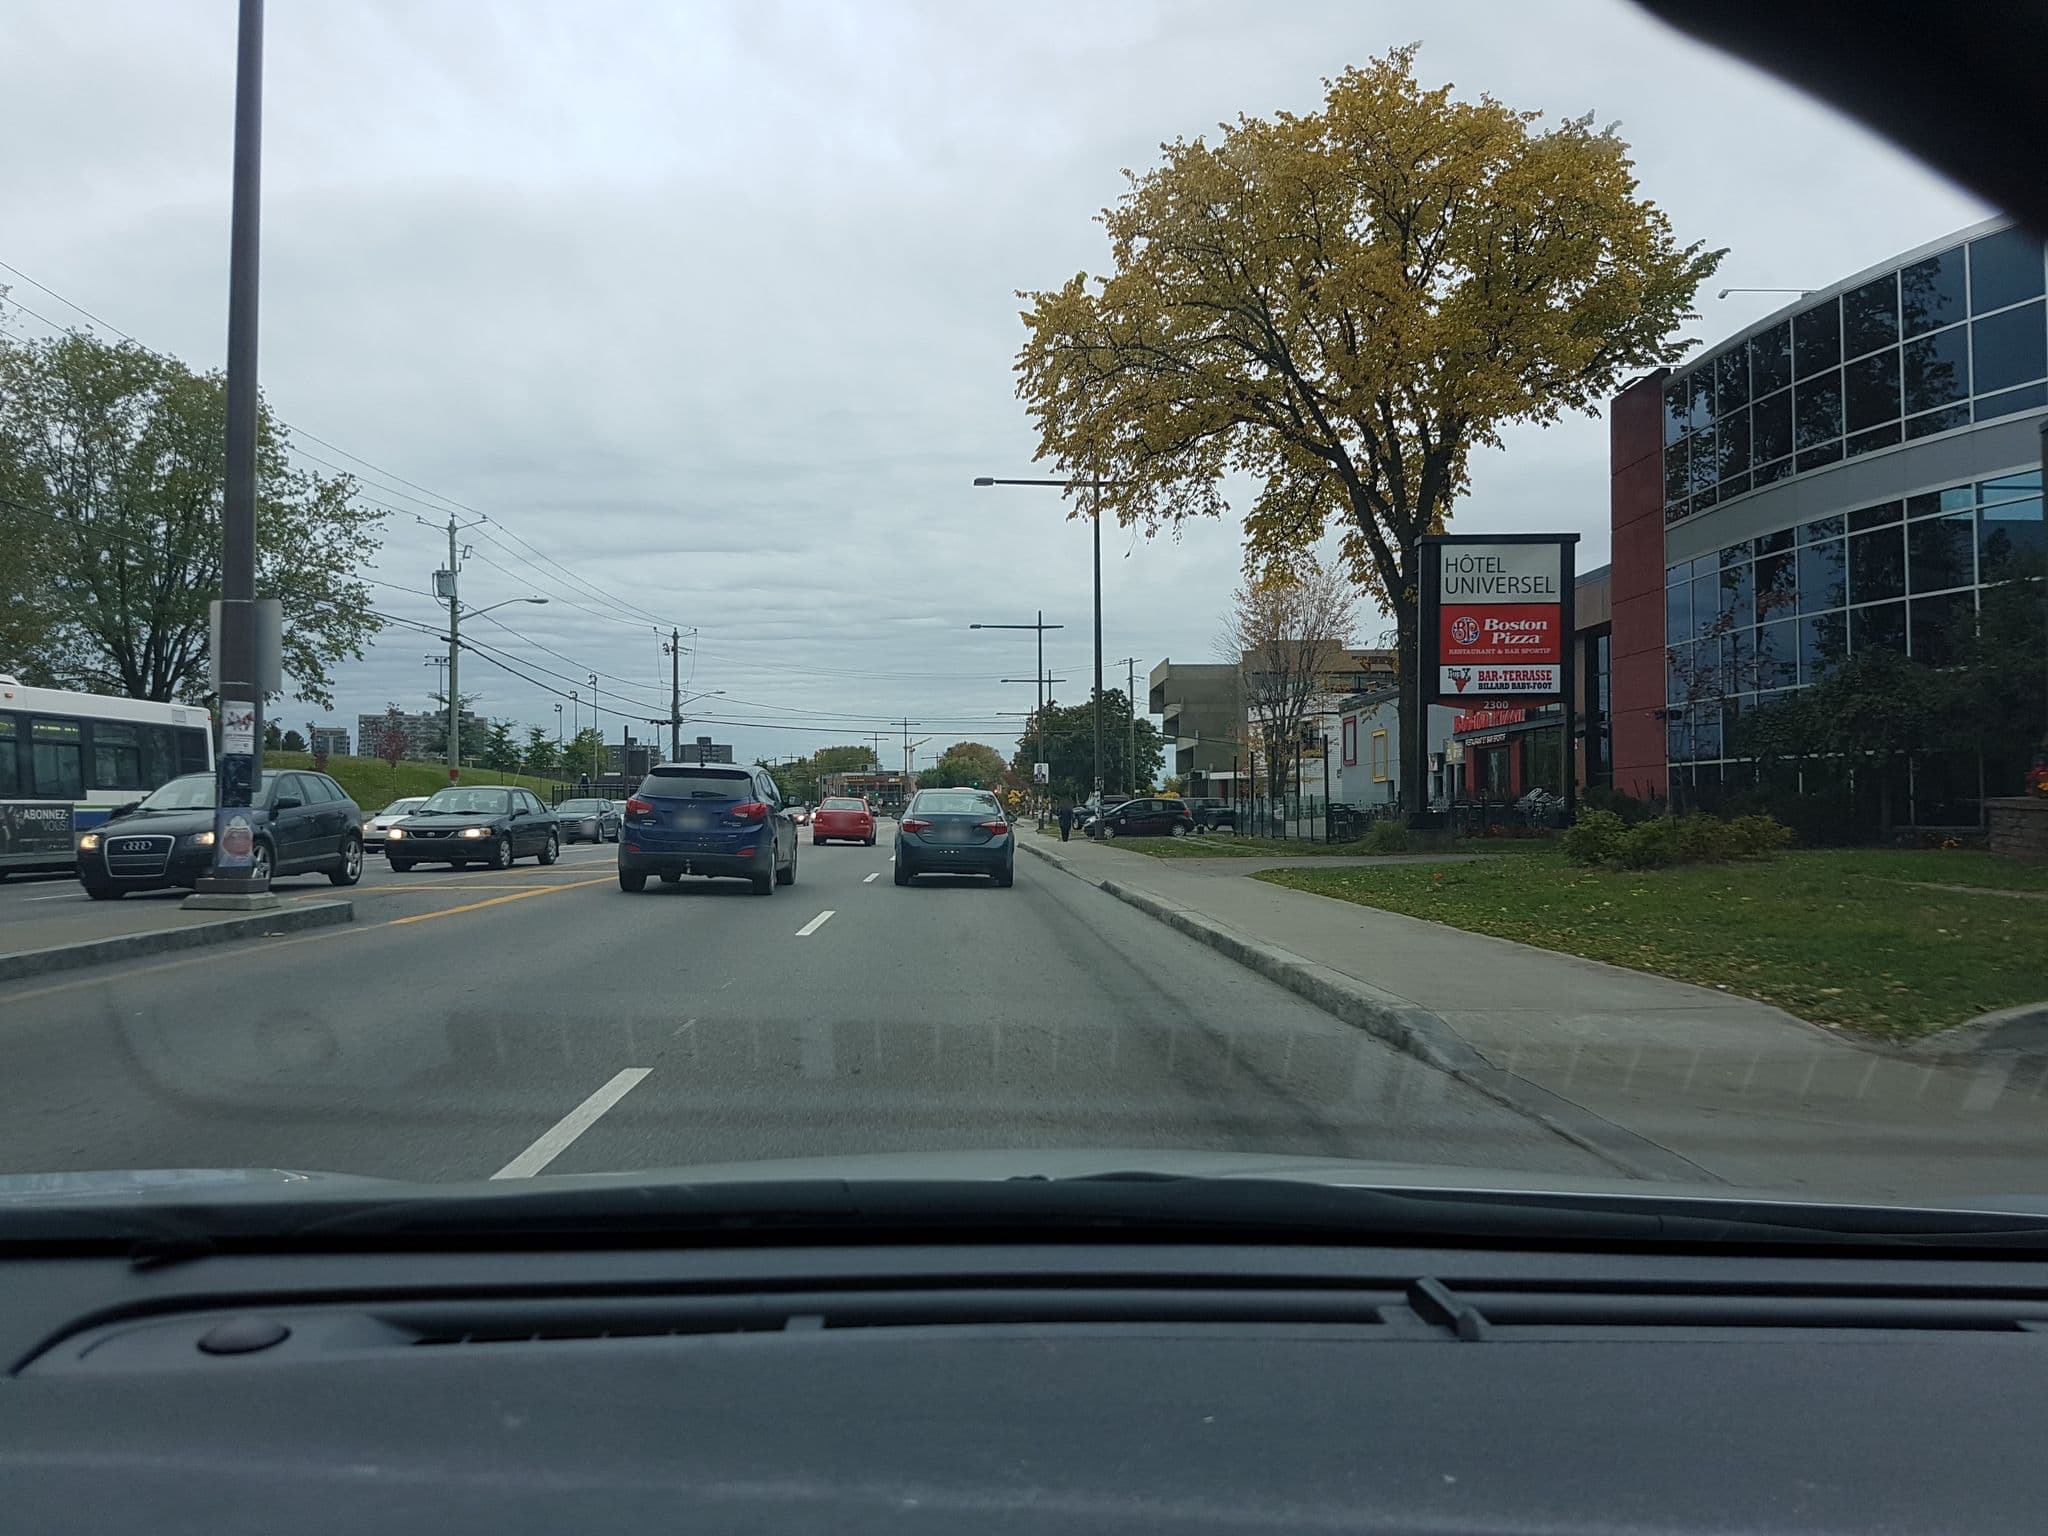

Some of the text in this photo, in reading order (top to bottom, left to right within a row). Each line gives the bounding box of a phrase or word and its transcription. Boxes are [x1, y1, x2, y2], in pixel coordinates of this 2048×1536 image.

[1445, 554, 1506, 573] HÔTEL
[1445, 576, 1555, 594] UNIVERSEL
[1484, 618, 1548, 631] Boston
[1492, 632, 1540, 644] Pizza
[1478, 682, 1510, 690] BILLARD
[1483, 701, 1509, 709] 2300
[23, 809, 69, 820] ABONNEZ-
